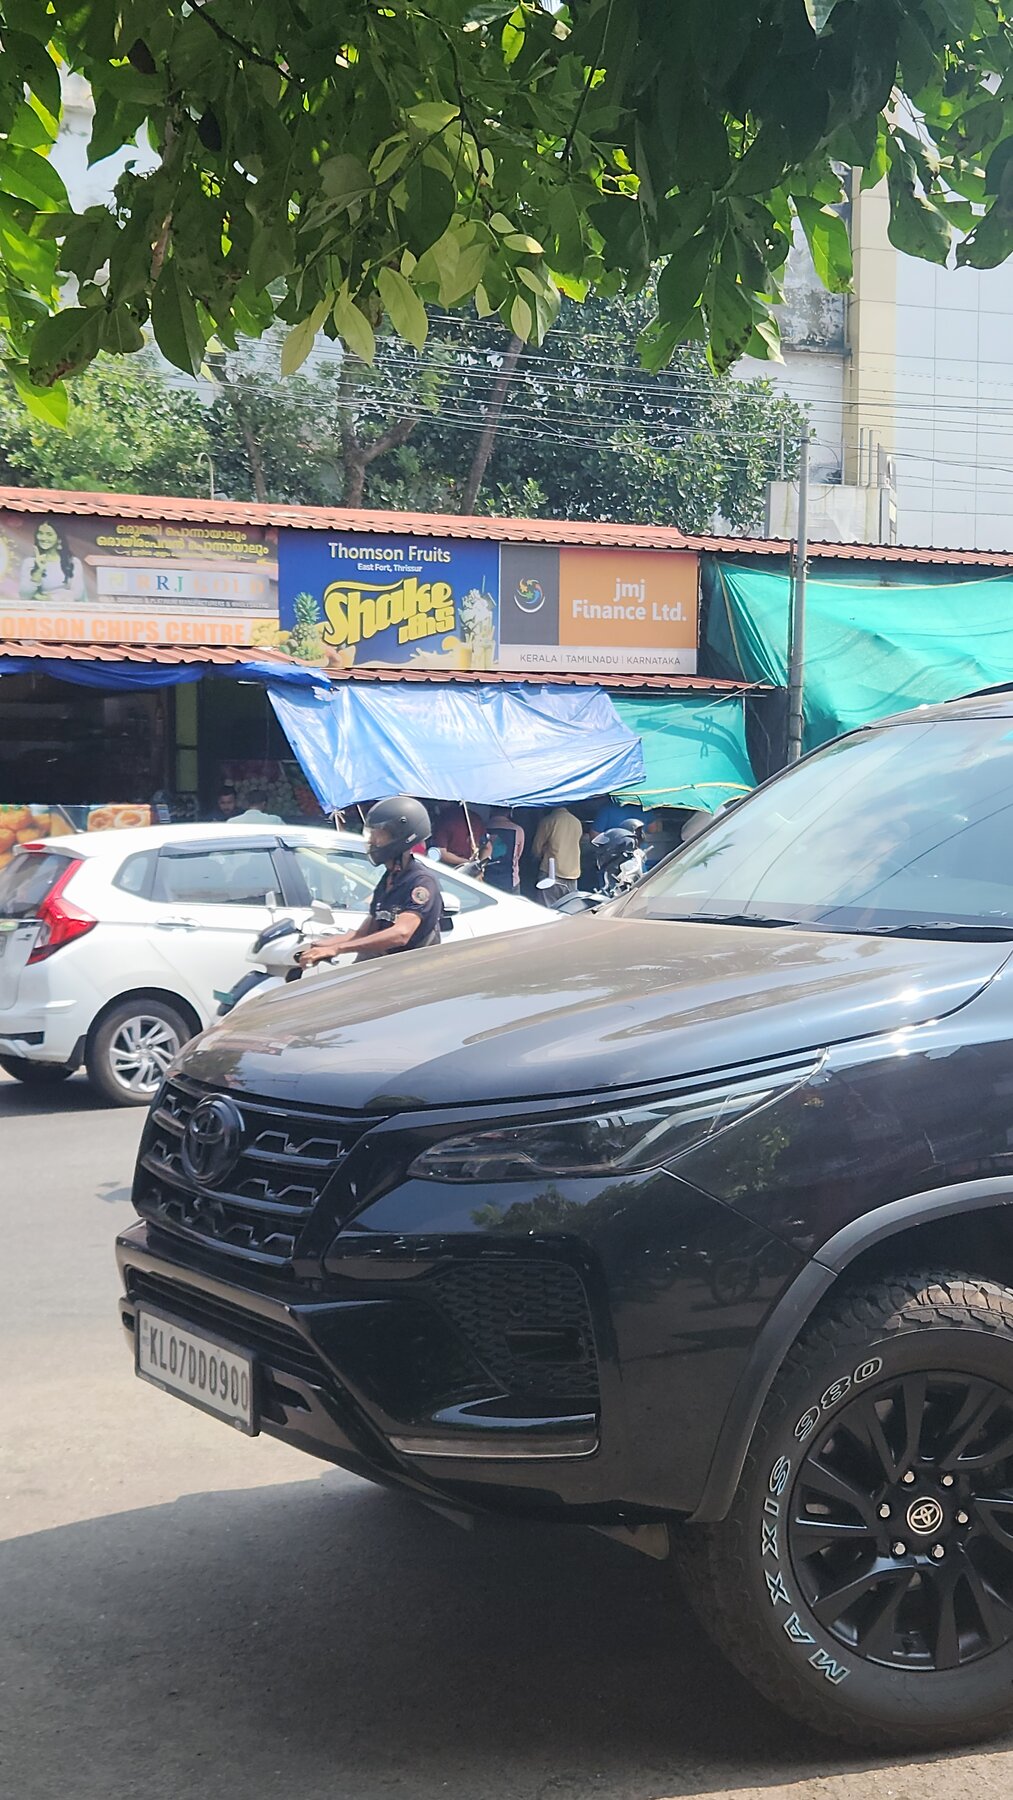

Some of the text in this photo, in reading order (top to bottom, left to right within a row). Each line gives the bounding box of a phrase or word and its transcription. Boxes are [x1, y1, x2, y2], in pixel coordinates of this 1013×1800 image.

[328, 542, 451, 563] Thomson Fruits
[357, 563, 423, 573] East Fort, Thrissur
[613, 577, 646, 603] jmj
[323, 577, 454, 646] Shake
[572, 599, 687, 622] Finance Ltd.
[0, 616, 245, 644] OMSON CHIPS CENTRE
[520, 653, 681, 666] KERALA TAMILNADU KARNATAKA
[149, 1325, 249, 1411] KL07DD0900
[761, 1357, 883, 1686] MAXXIS 980
